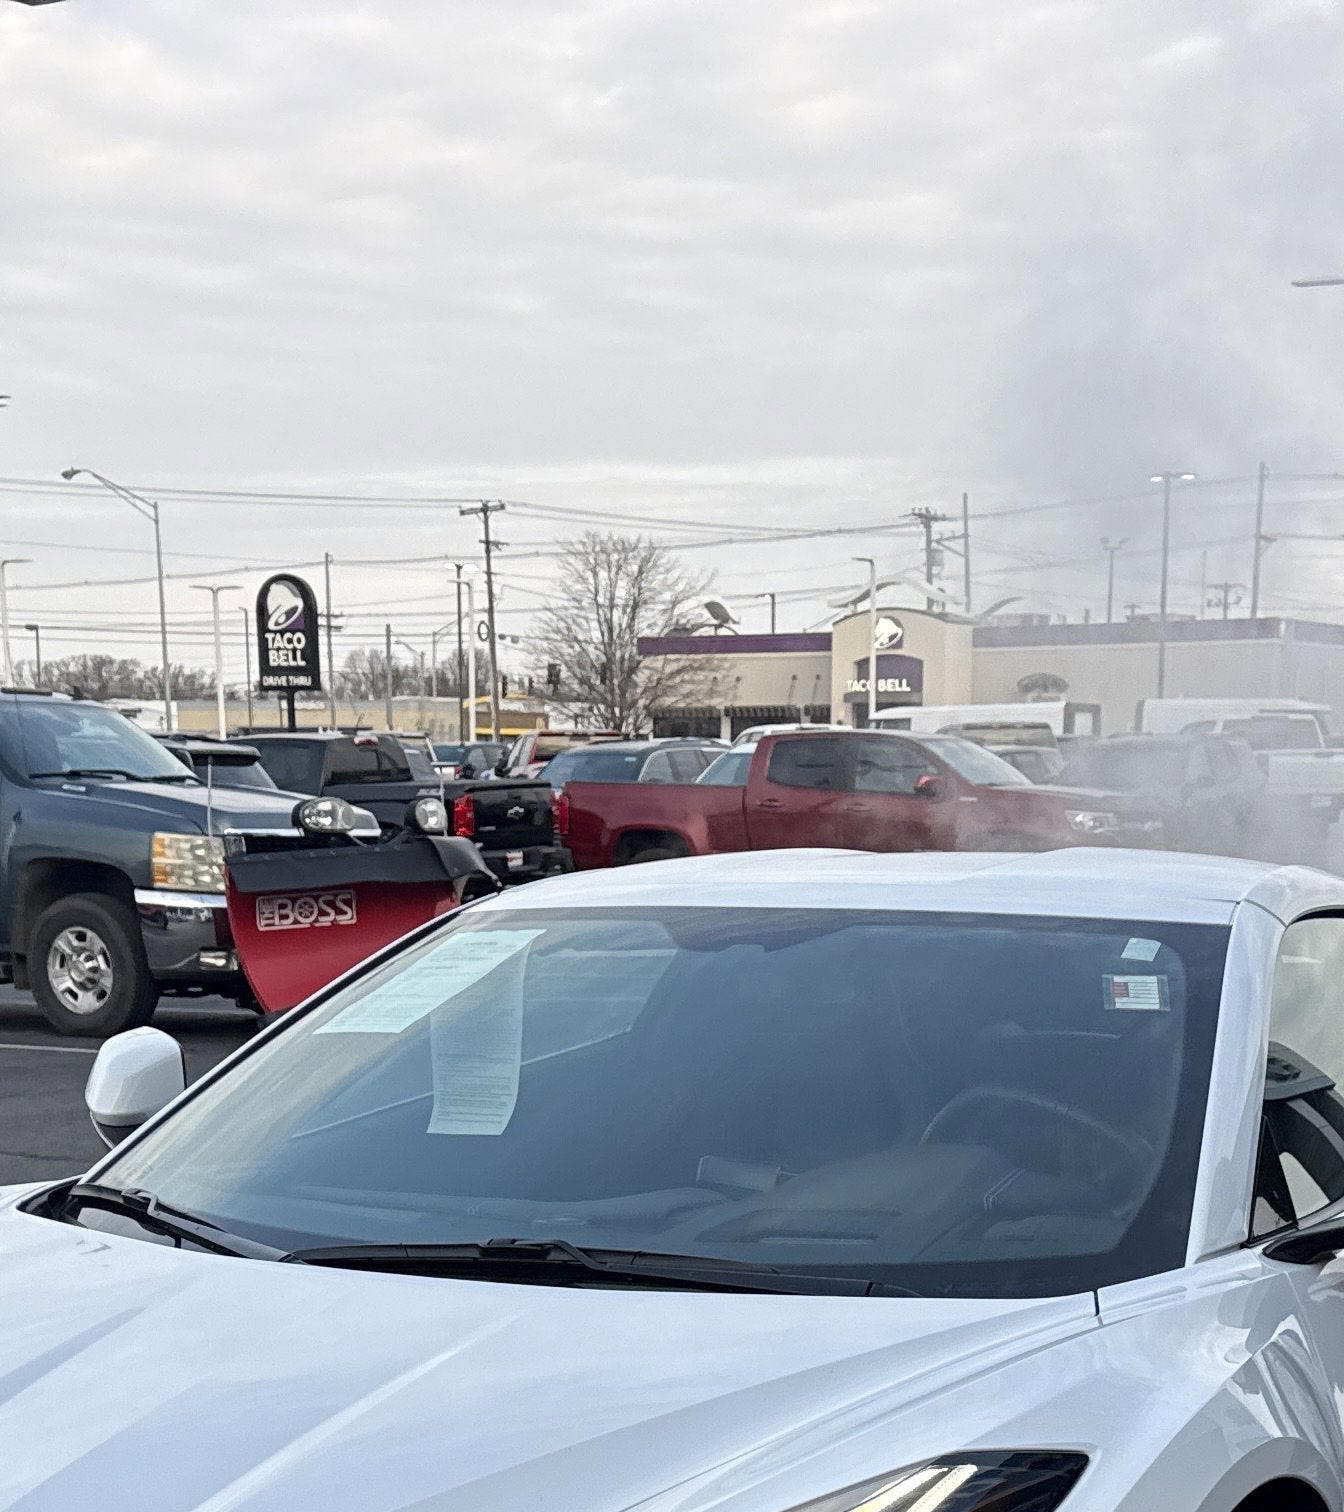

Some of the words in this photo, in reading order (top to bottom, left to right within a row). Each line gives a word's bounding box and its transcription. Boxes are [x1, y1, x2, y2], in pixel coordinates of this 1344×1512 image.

[264, 632, 306, 649] TACO
[268, 649, 307, 667] BELL
[262, 675, 288, 686] DRIVE
[289, 675, 312, 686] THRU
[877, 678, 912, 692] BELL
[274, 895, 352, 925] BOSS
